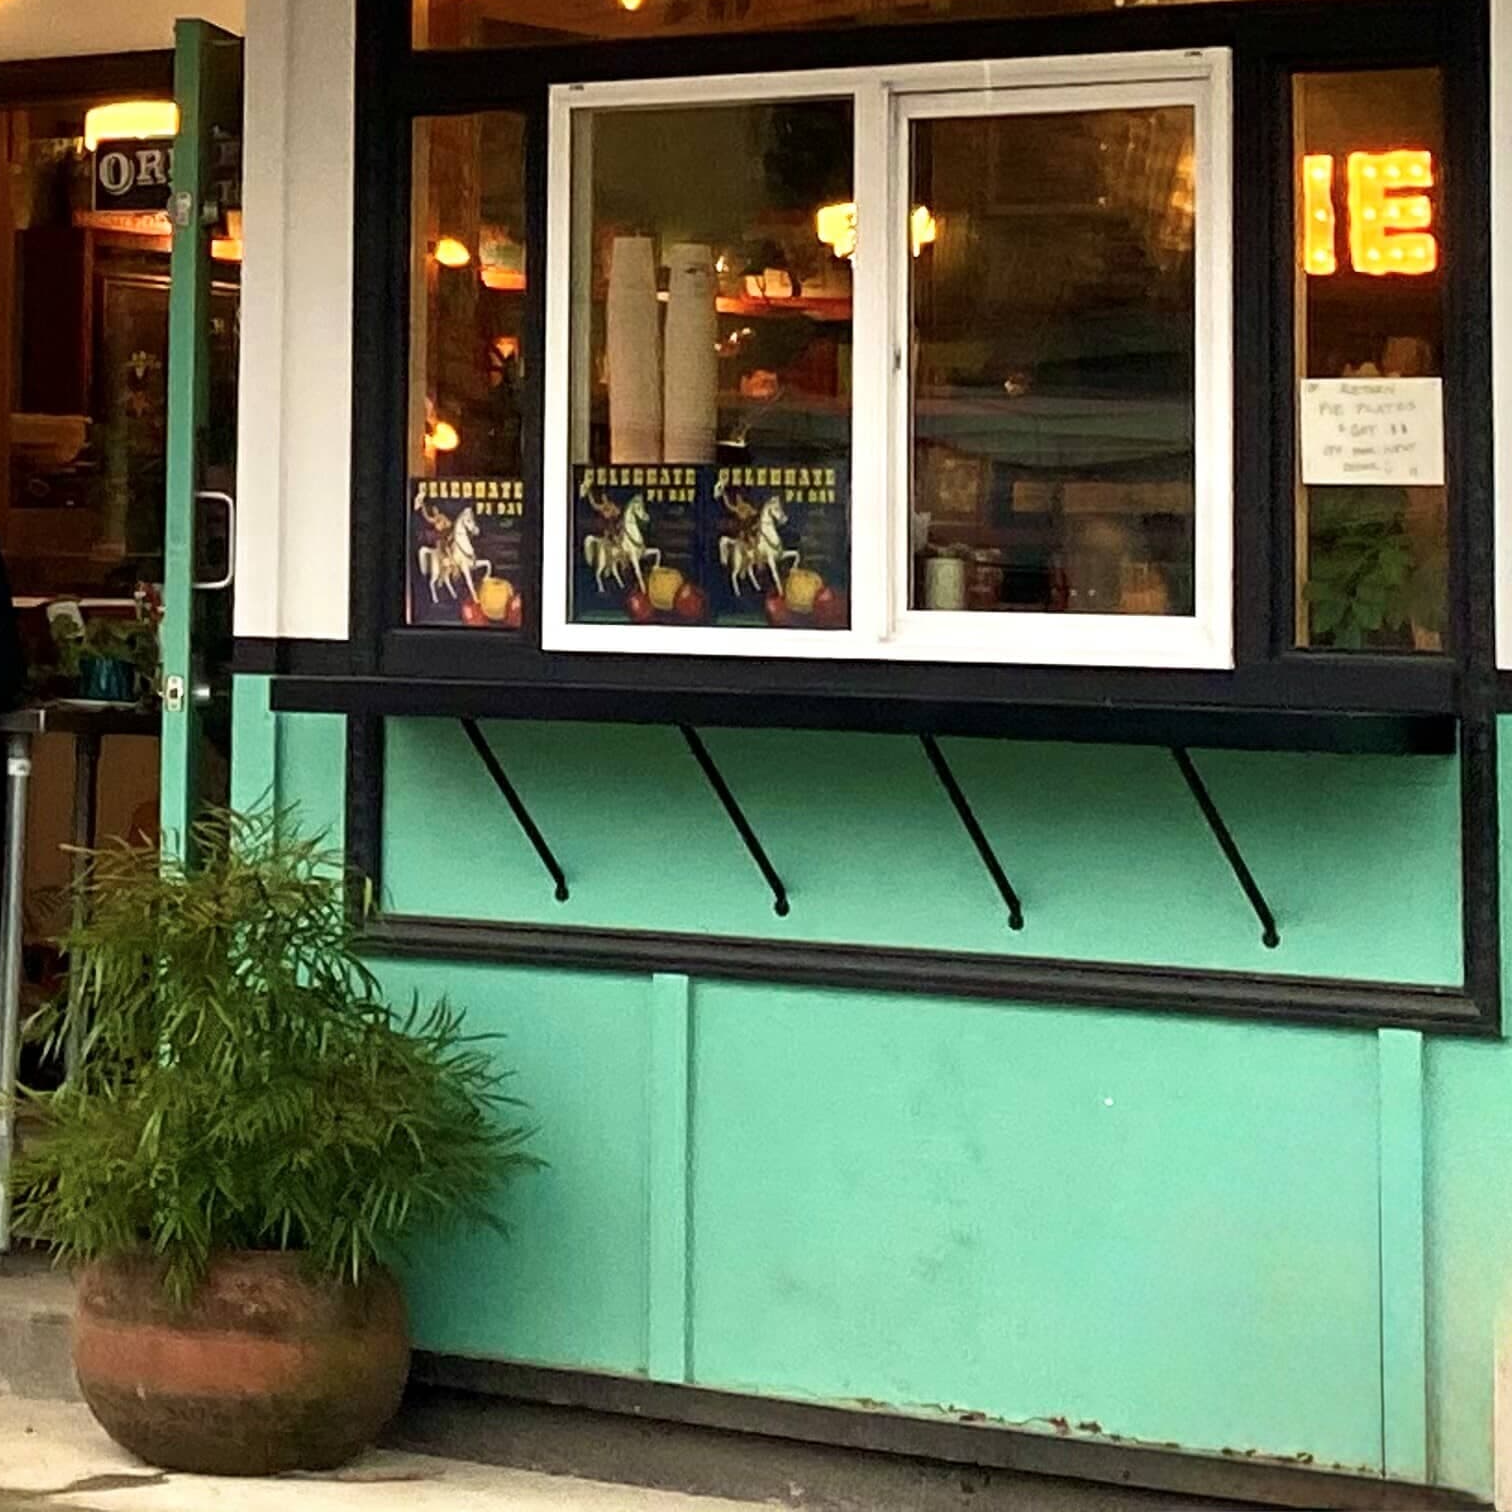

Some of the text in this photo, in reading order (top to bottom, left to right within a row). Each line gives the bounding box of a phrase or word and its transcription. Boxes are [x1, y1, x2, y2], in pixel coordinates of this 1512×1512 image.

[98, 147, 175, 196] OR
[585, 468, 696, 486] CELEBRATE
[719, 468, 835, 486] CELEBRATE
[419, 481, 523, 499] CELEBRATE
